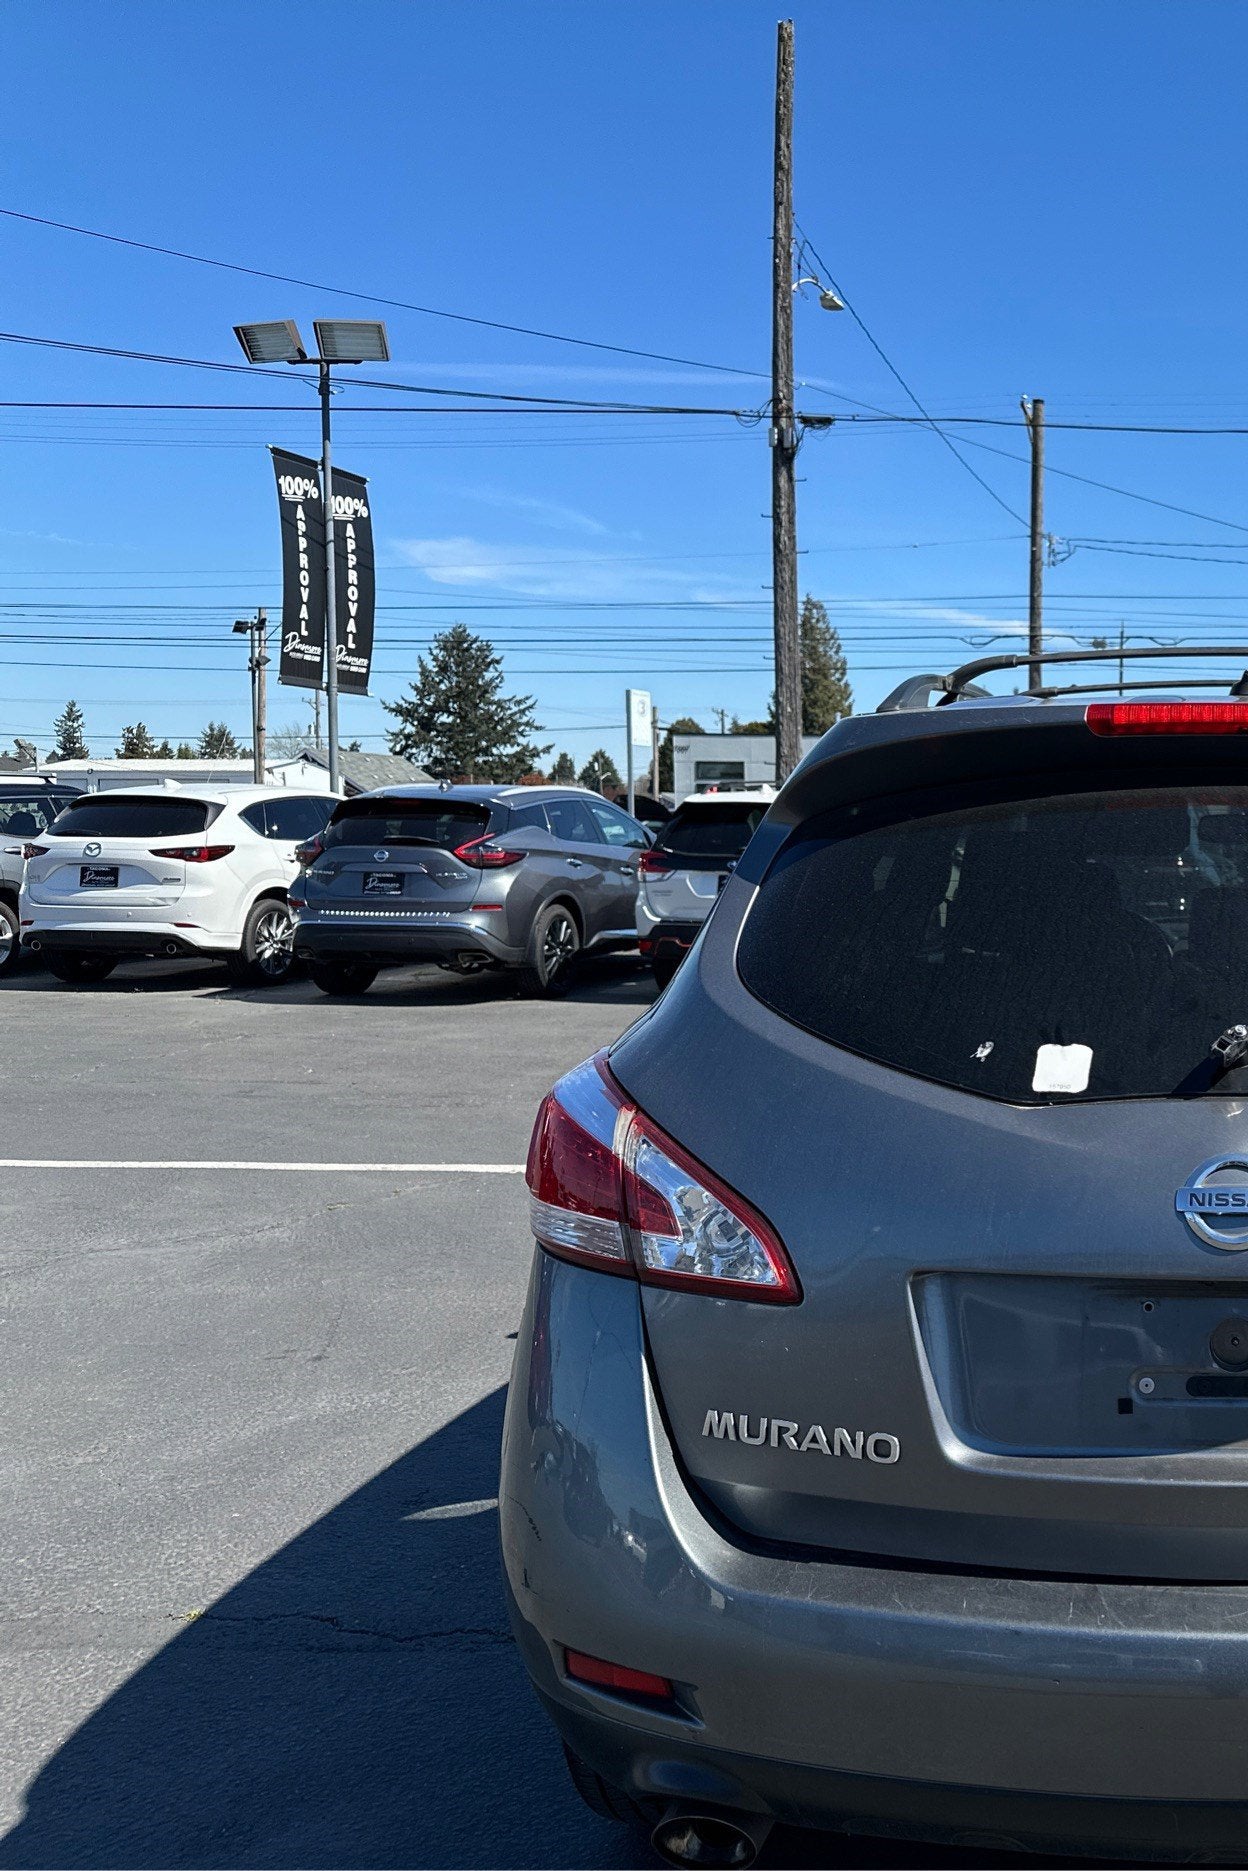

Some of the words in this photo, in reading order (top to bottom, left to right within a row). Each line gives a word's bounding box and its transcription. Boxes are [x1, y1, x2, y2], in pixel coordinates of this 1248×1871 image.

[279, 475, 319, 499] 100%
[331, 495, 369, 518] 100%
[296, 504, 310, 636] APPROVAL
[345, 522, 359, 650] APPROVAL
[702, 1409, 901, 1465] MURANO
